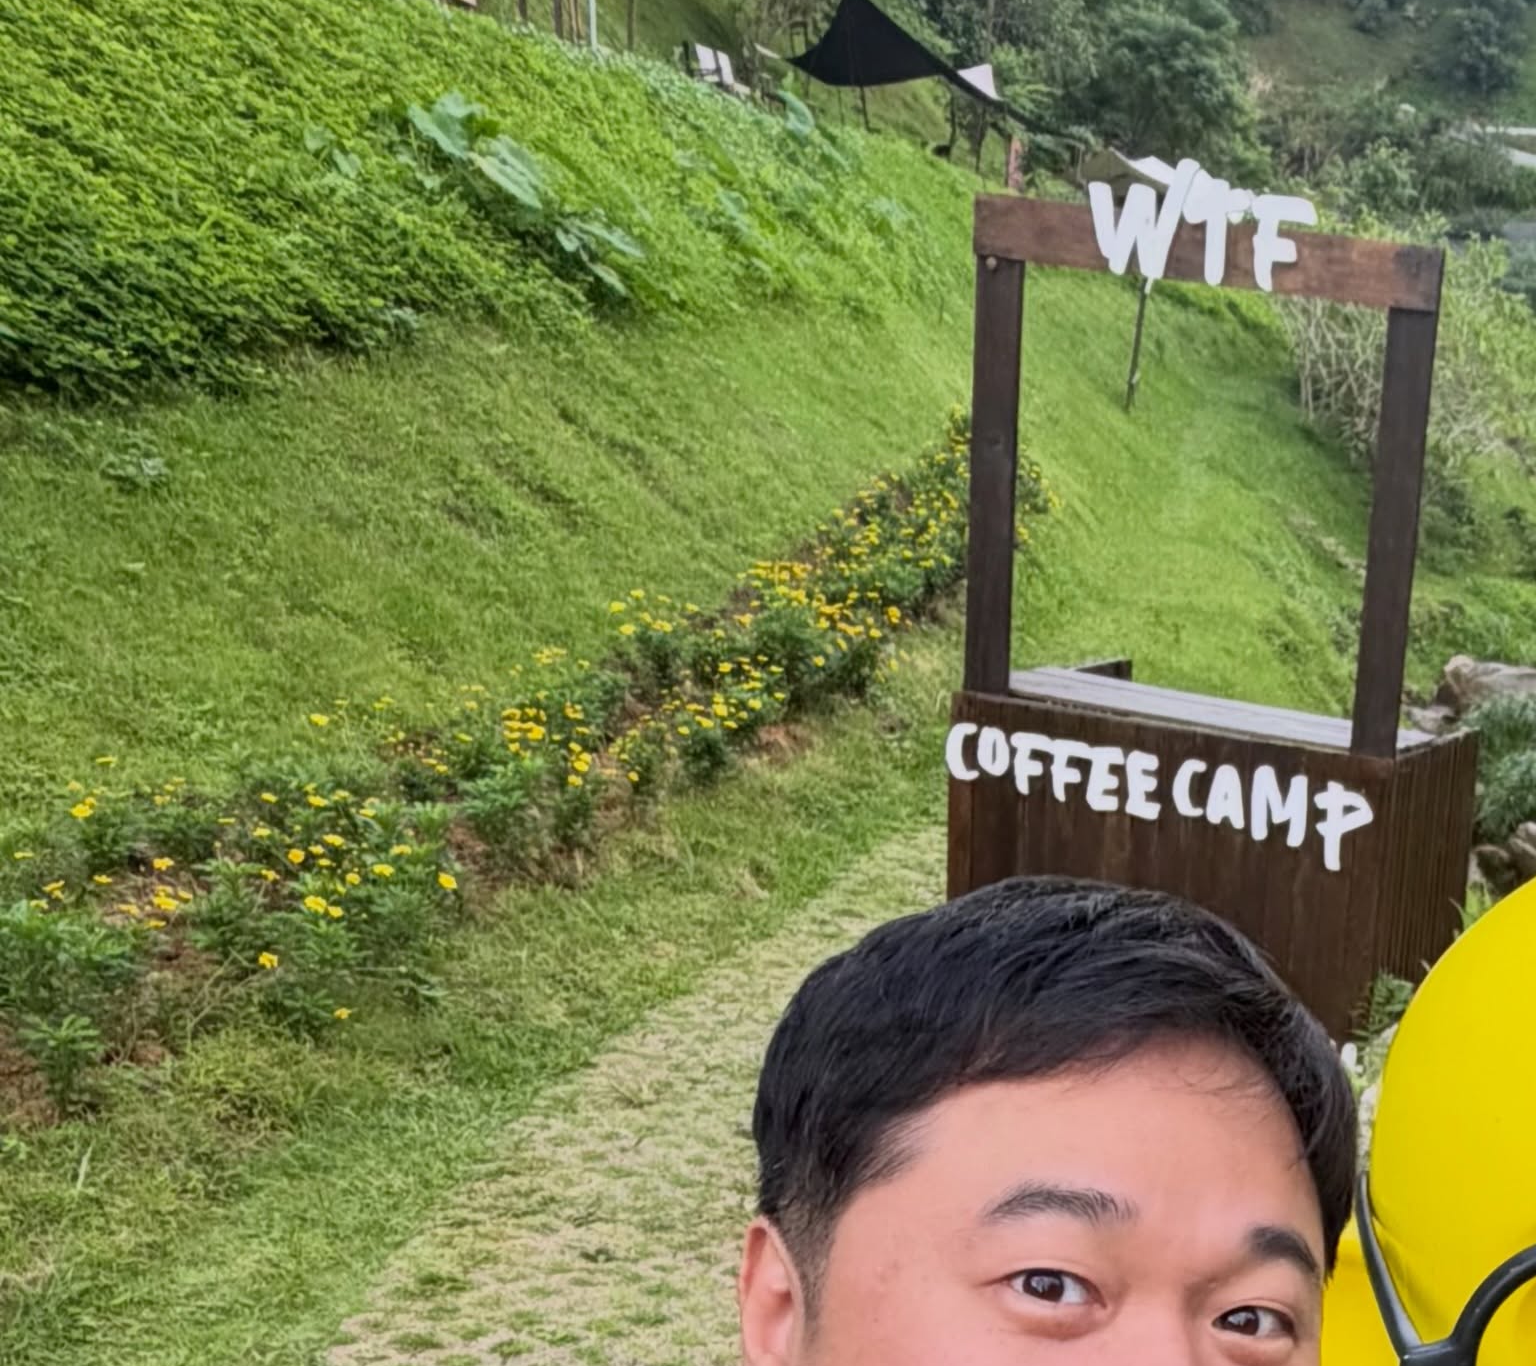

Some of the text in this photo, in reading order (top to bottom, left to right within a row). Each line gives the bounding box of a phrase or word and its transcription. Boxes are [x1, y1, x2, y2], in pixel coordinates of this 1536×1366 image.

[1087, 158, 1318, 294] WTF
[945, 722, 1375, 873] COFFEE CAMP
